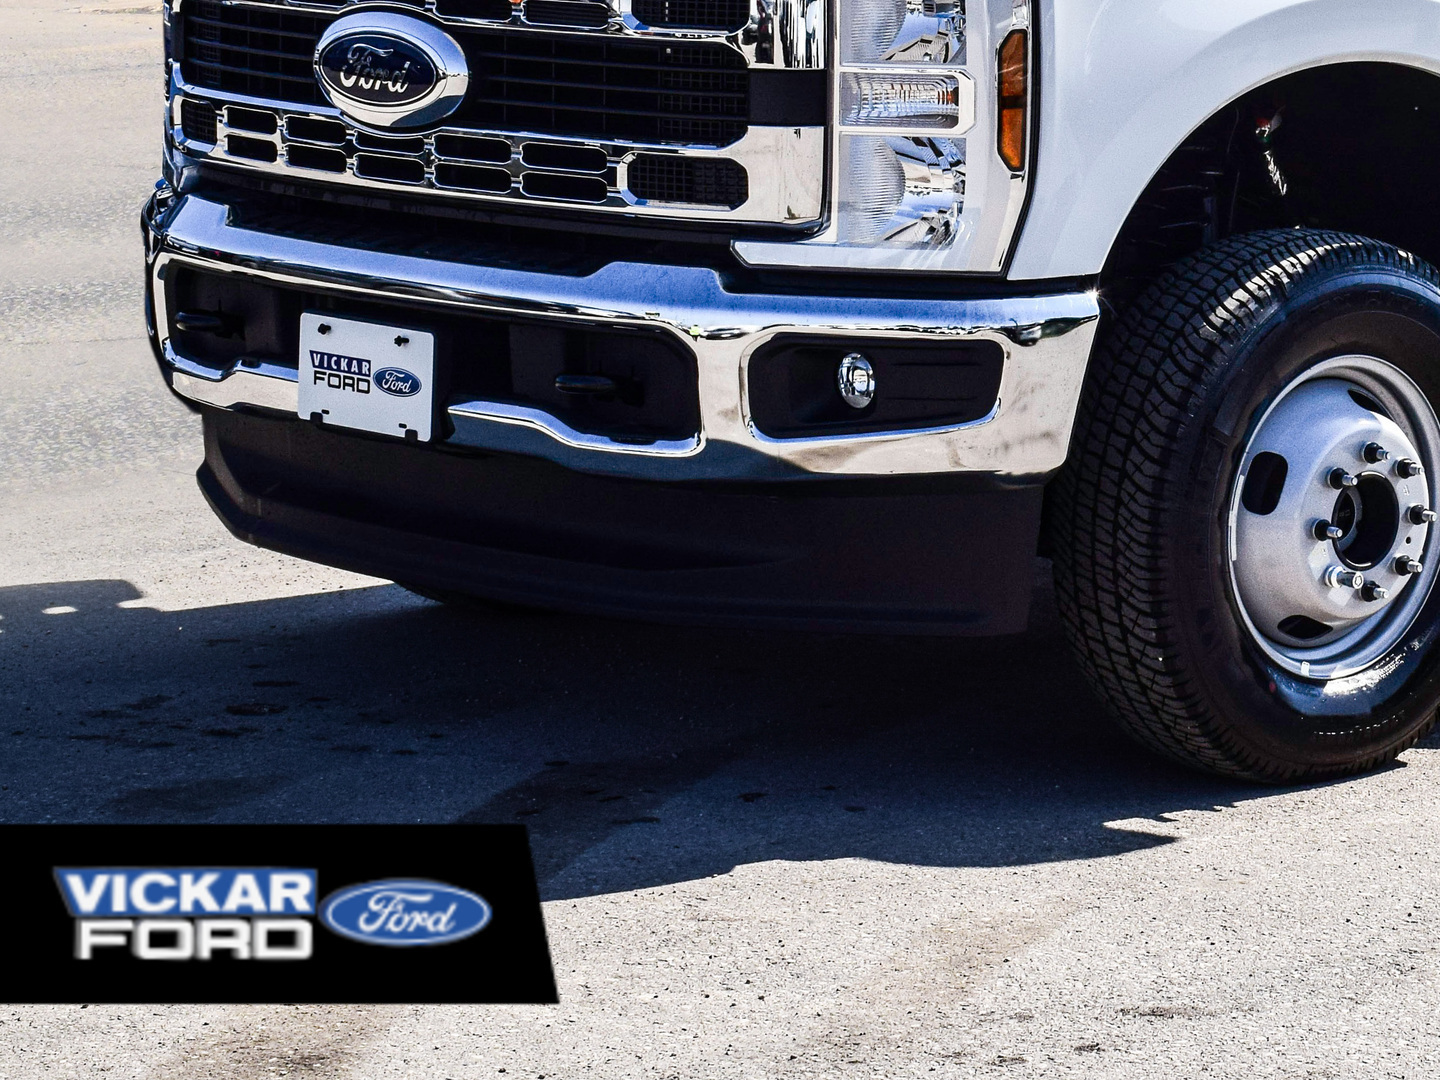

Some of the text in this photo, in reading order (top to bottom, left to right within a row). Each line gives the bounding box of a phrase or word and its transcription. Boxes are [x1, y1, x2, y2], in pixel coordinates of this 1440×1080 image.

[340, 42, 413, 94] Ford
[313, 352, 370, 375] VICKAR
[313, 370, 412, 395] FORD Ford
